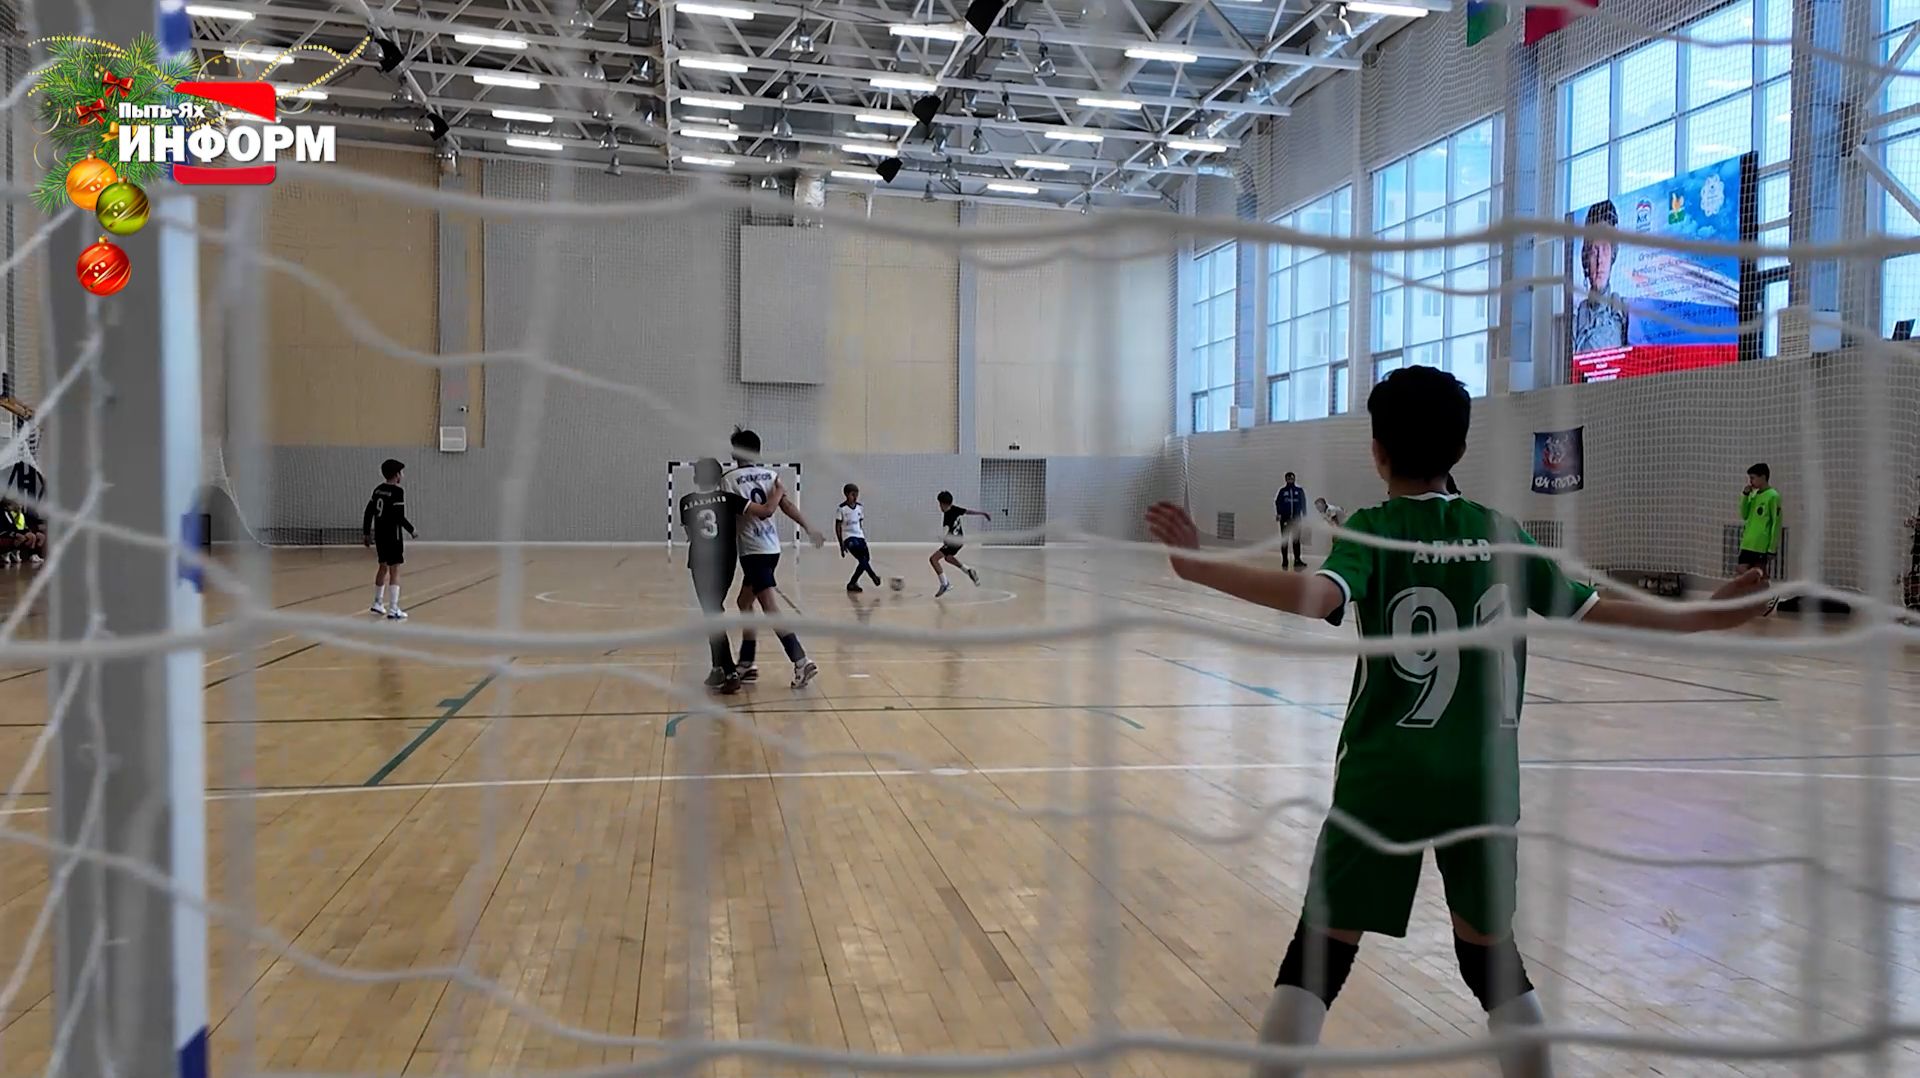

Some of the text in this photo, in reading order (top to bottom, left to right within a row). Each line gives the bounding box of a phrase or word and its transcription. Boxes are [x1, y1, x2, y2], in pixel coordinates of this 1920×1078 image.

[376, 498, 384, 517] 9
[697, 509, 719, 539] 3
[1386, 583, 1519, 728] 91
